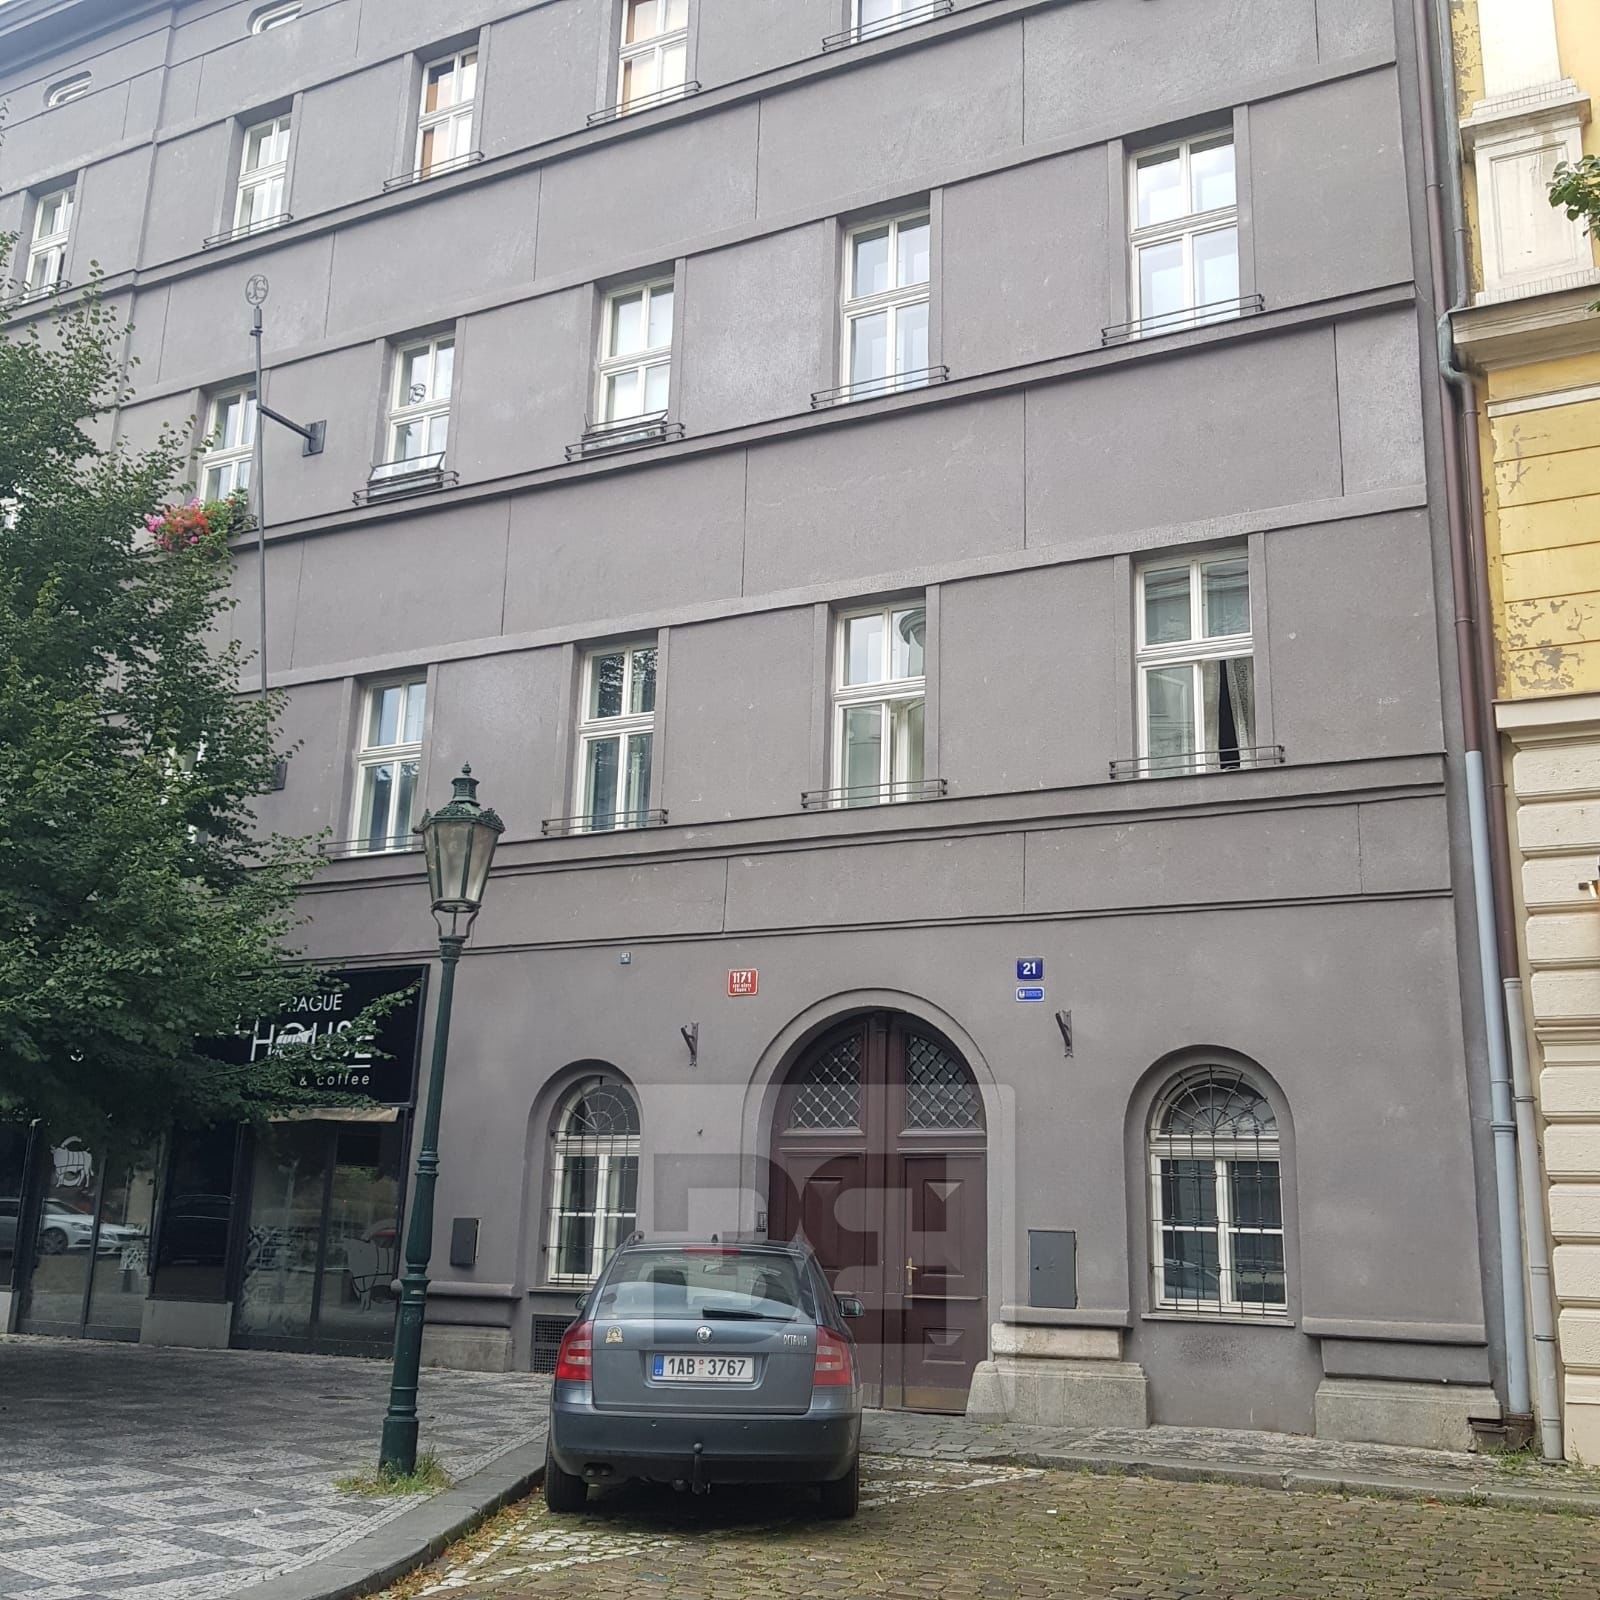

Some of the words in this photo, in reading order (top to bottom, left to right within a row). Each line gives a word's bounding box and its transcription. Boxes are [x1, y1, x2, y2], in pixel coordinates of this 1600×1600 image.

[1023, 961, 1036, 975] 21
[733, 972, 752, 984] 1171
[668, 1358, 695, 1376] 1AB
[708, 1359, 746, 1377] 3767
